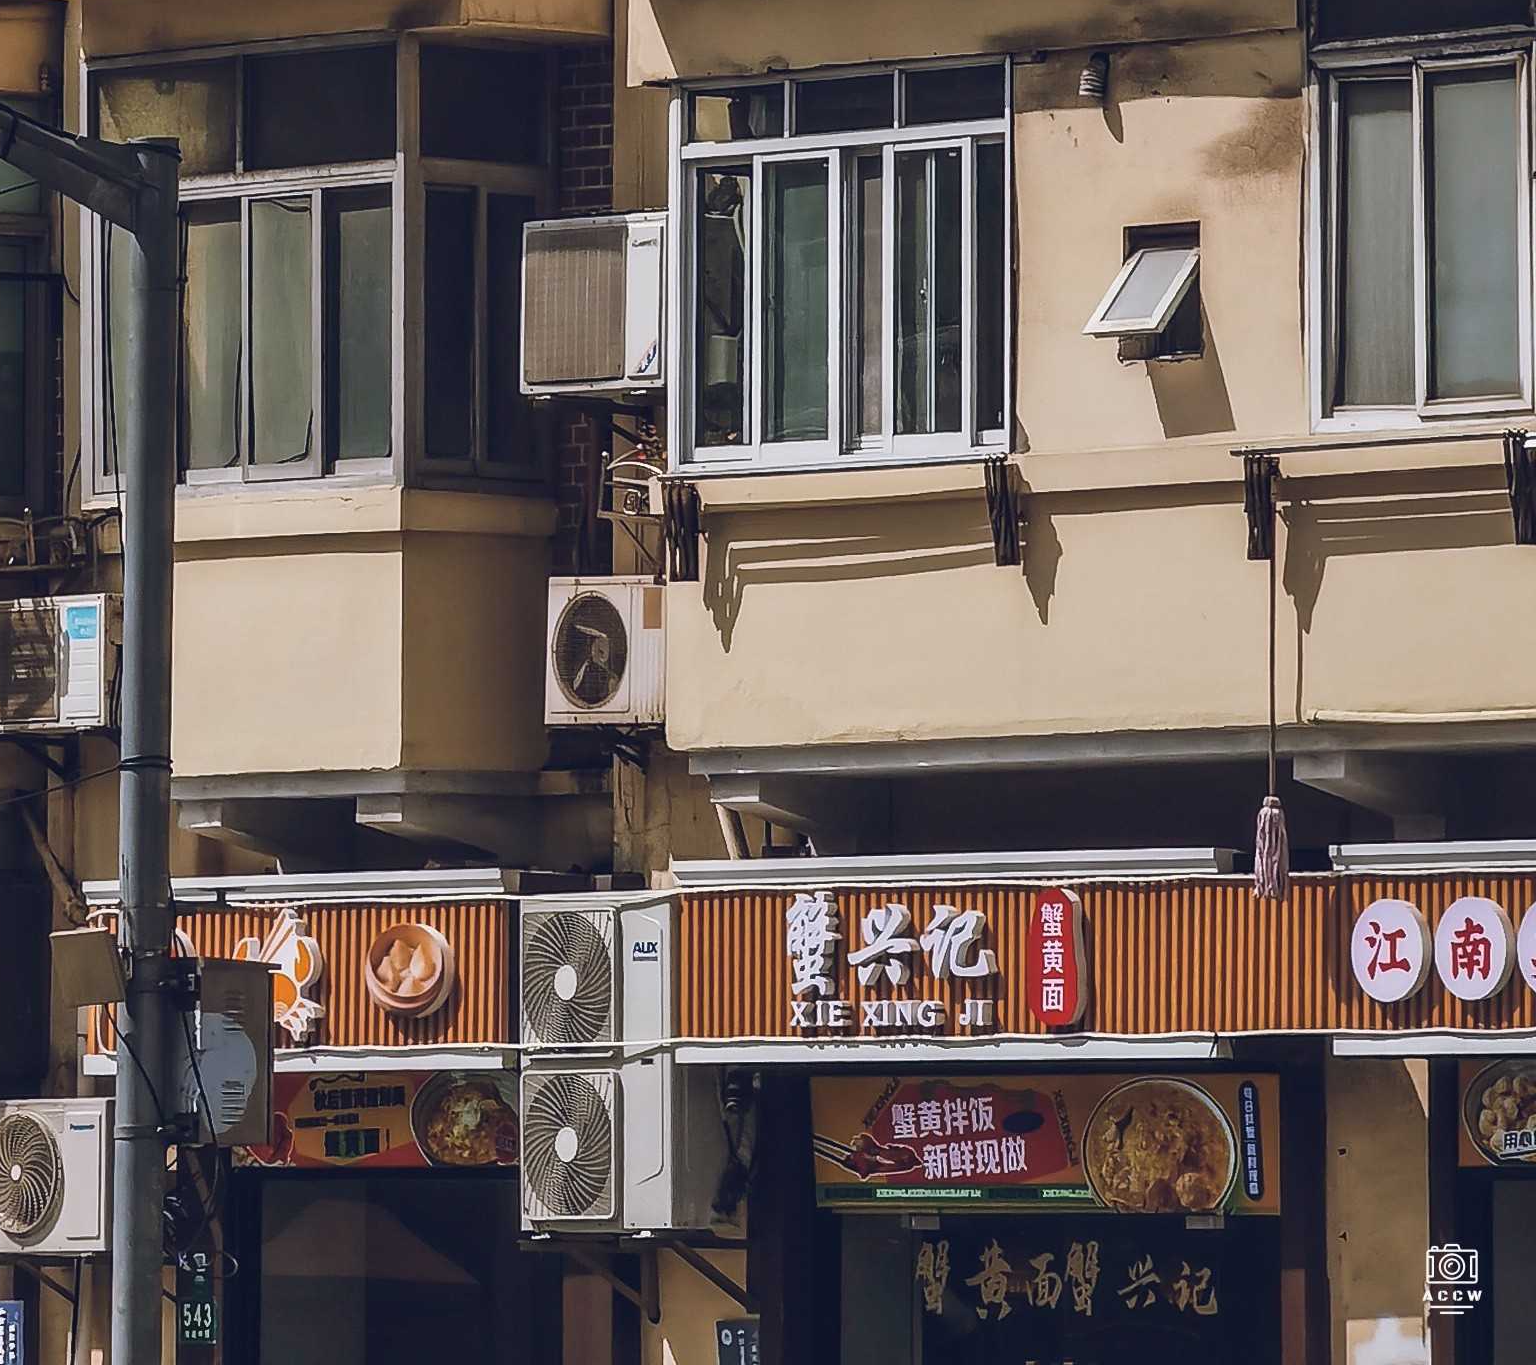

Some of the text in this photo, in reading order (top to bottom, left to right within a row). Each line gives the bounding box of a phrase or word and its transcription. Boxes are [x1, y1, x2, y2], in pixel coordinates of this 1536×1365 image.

[633, 941, 659, 954] AUX
[785, 891, 998, 997] 蟹兴记
[1041, 902, 1065, 1012] 蟹黄面
[1364, 916, 1536, 981] 江南
[790, 999, 996, 1028] XIE XING JI
[890, 1096, 996, 1140] 蟹黄拌饭
[921, 1135, 1029, 1180] 新鲜现做
[183, 1303, 212, 1328] 543
